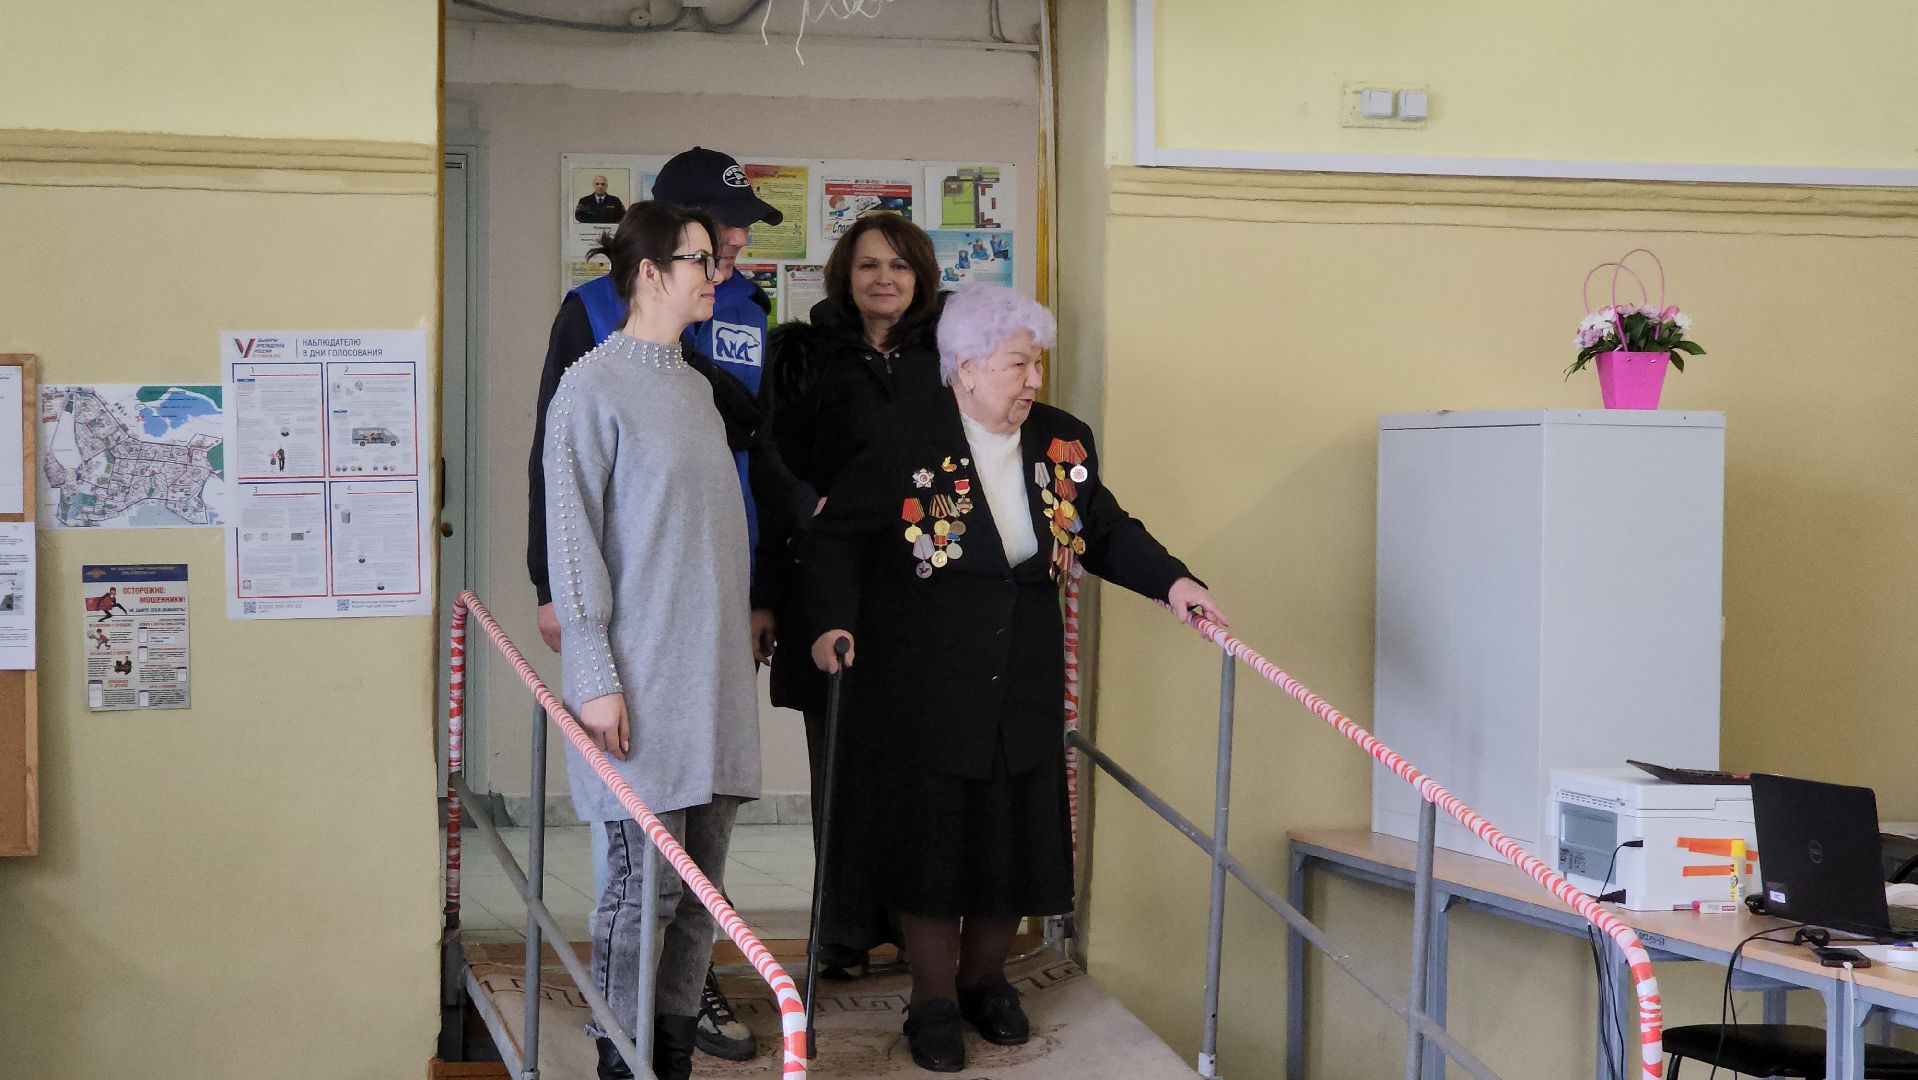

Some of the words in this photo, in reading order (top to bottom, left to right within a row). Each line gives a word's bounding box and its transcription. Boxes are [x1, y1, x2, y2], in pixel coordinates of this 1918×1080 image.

[302, 338, 361, 347] НАБЛЮДАТЕЛЮ
[302, 349, 308, 357] В
[309, 349, 326, 358] ДНИ
[328, 348, 383, 357] ГОЛОСОВАНИЯ
[344, 365, 349, 373] 2
[139, 596, 186, 604] МОШЕННИКИ!
